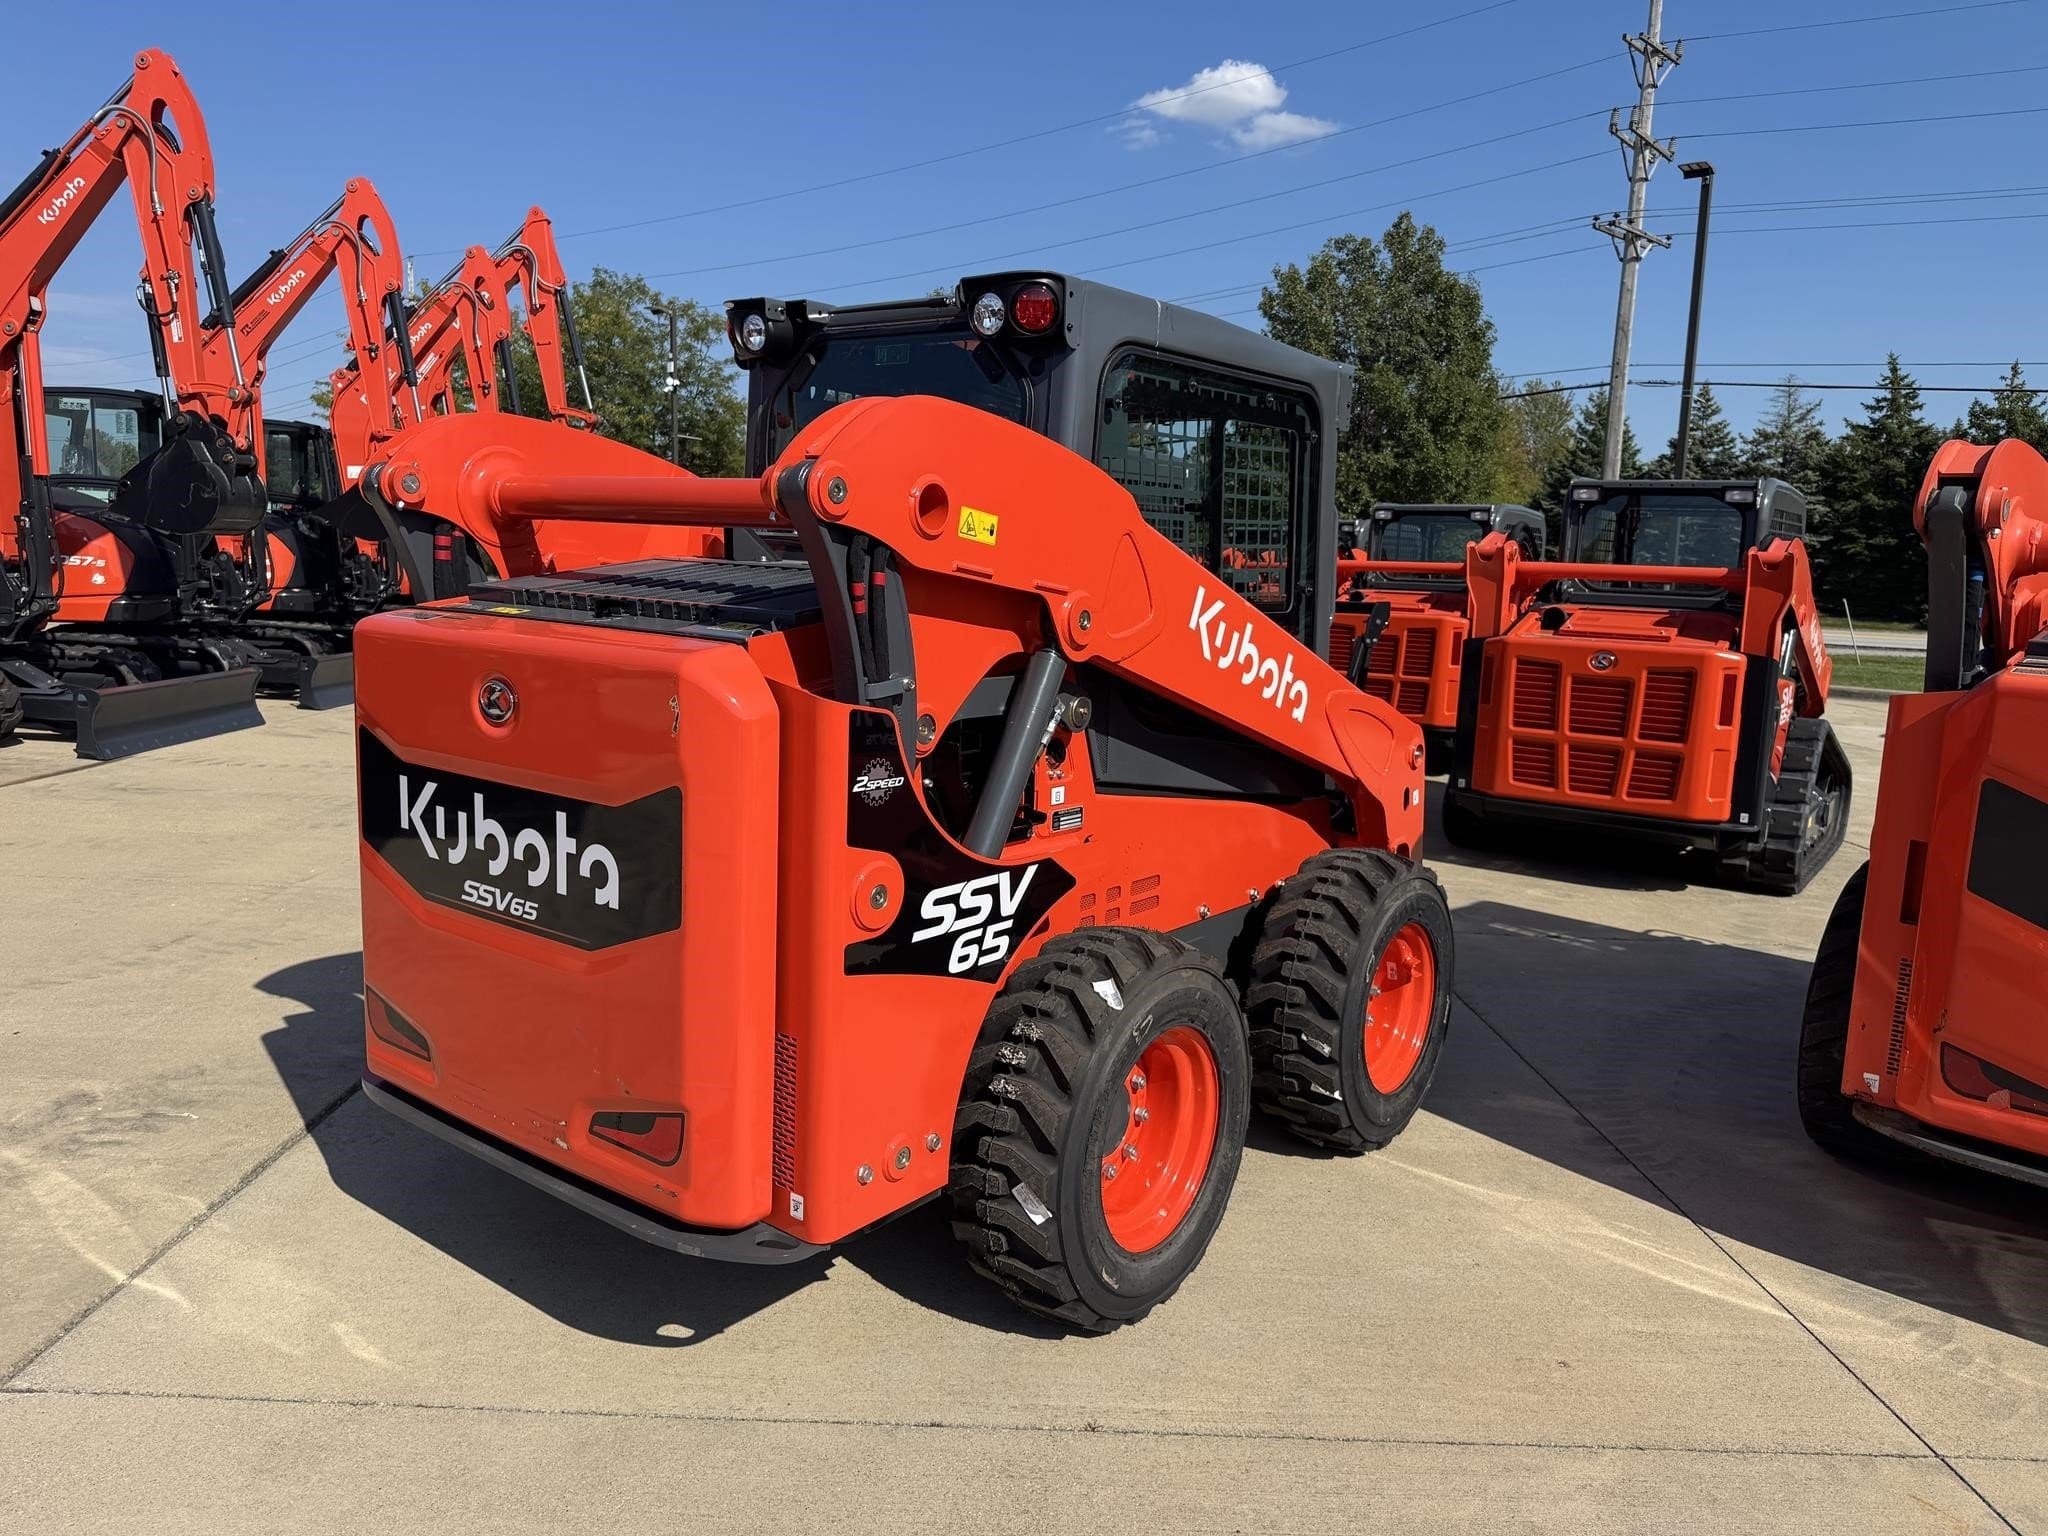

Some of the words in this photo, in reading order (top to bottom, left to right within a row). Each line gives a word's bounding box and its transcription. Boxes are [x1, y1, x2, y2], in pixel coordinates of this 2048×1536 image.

[37, 176, 86, 225] Kubota
[266, 269, 306, 306] Kubota
[1188, 584, 1309, 724] Kubota
[399, 774, 620, 911] Kubota
[461, 879, 539, 921] SSV65
[911, 863, 1039, 944] SSV
[948, 918, 1014, 974] 65
